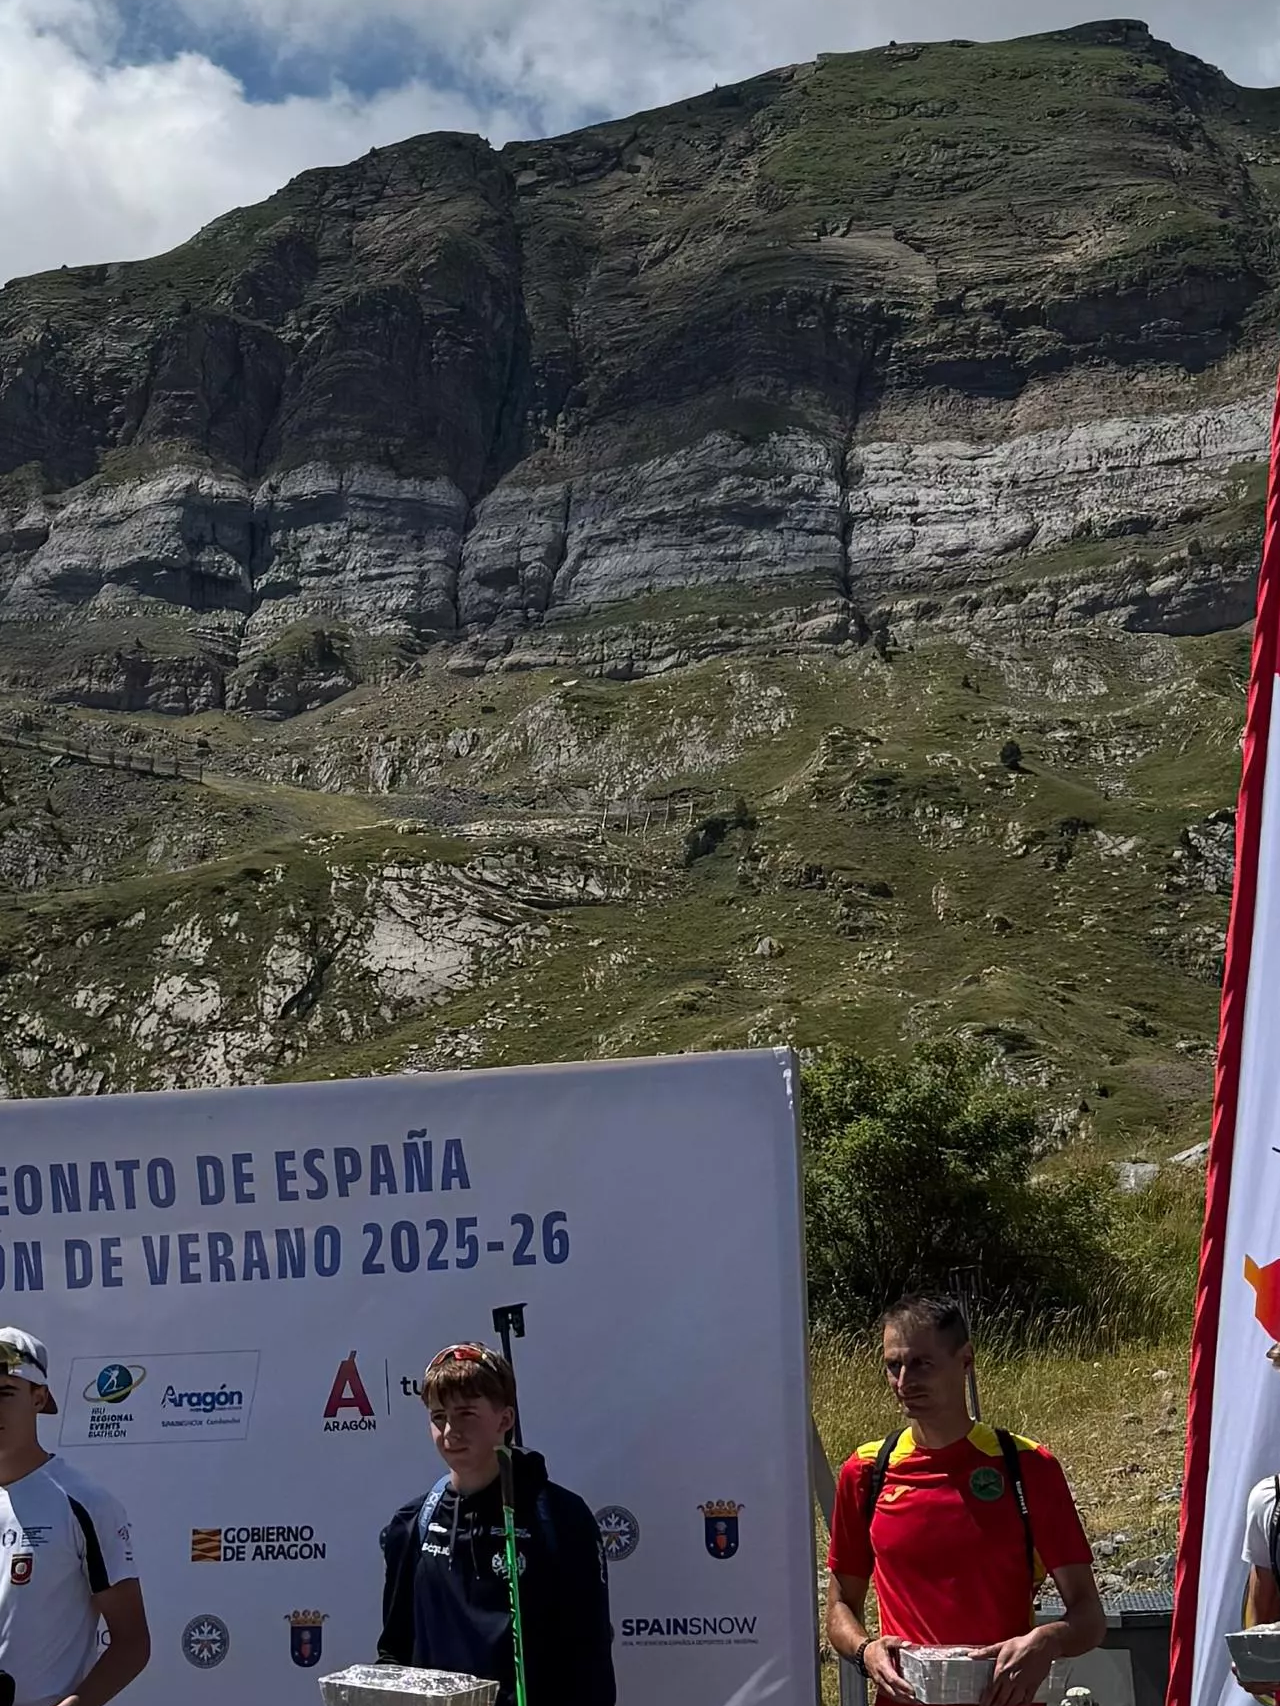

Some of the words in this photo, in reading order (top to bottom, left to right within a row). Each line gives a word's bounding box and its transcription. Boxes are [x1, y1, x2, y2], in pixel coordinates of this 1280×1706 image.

[197, 1153, 256, 1207] DE
[276, 1128, 472, 1202] ESPAÑA
[66, 1236, 123, 1289] DE
[143, 1225, 342, 1286] VERANO
[360, 1210, 571, 1276] 2025-26
[161, 1384, 243, 1413] Aragón
[324, 1416, 376, 1432] ARAGÓN
[223, 1526, 314, 1544] GOBIERNO
[223, 1545, 246, 1562] DE
[251, 1543, 327, 1561] ARAGON
[621, 1617, 758, 1637] SPAINSNOW
